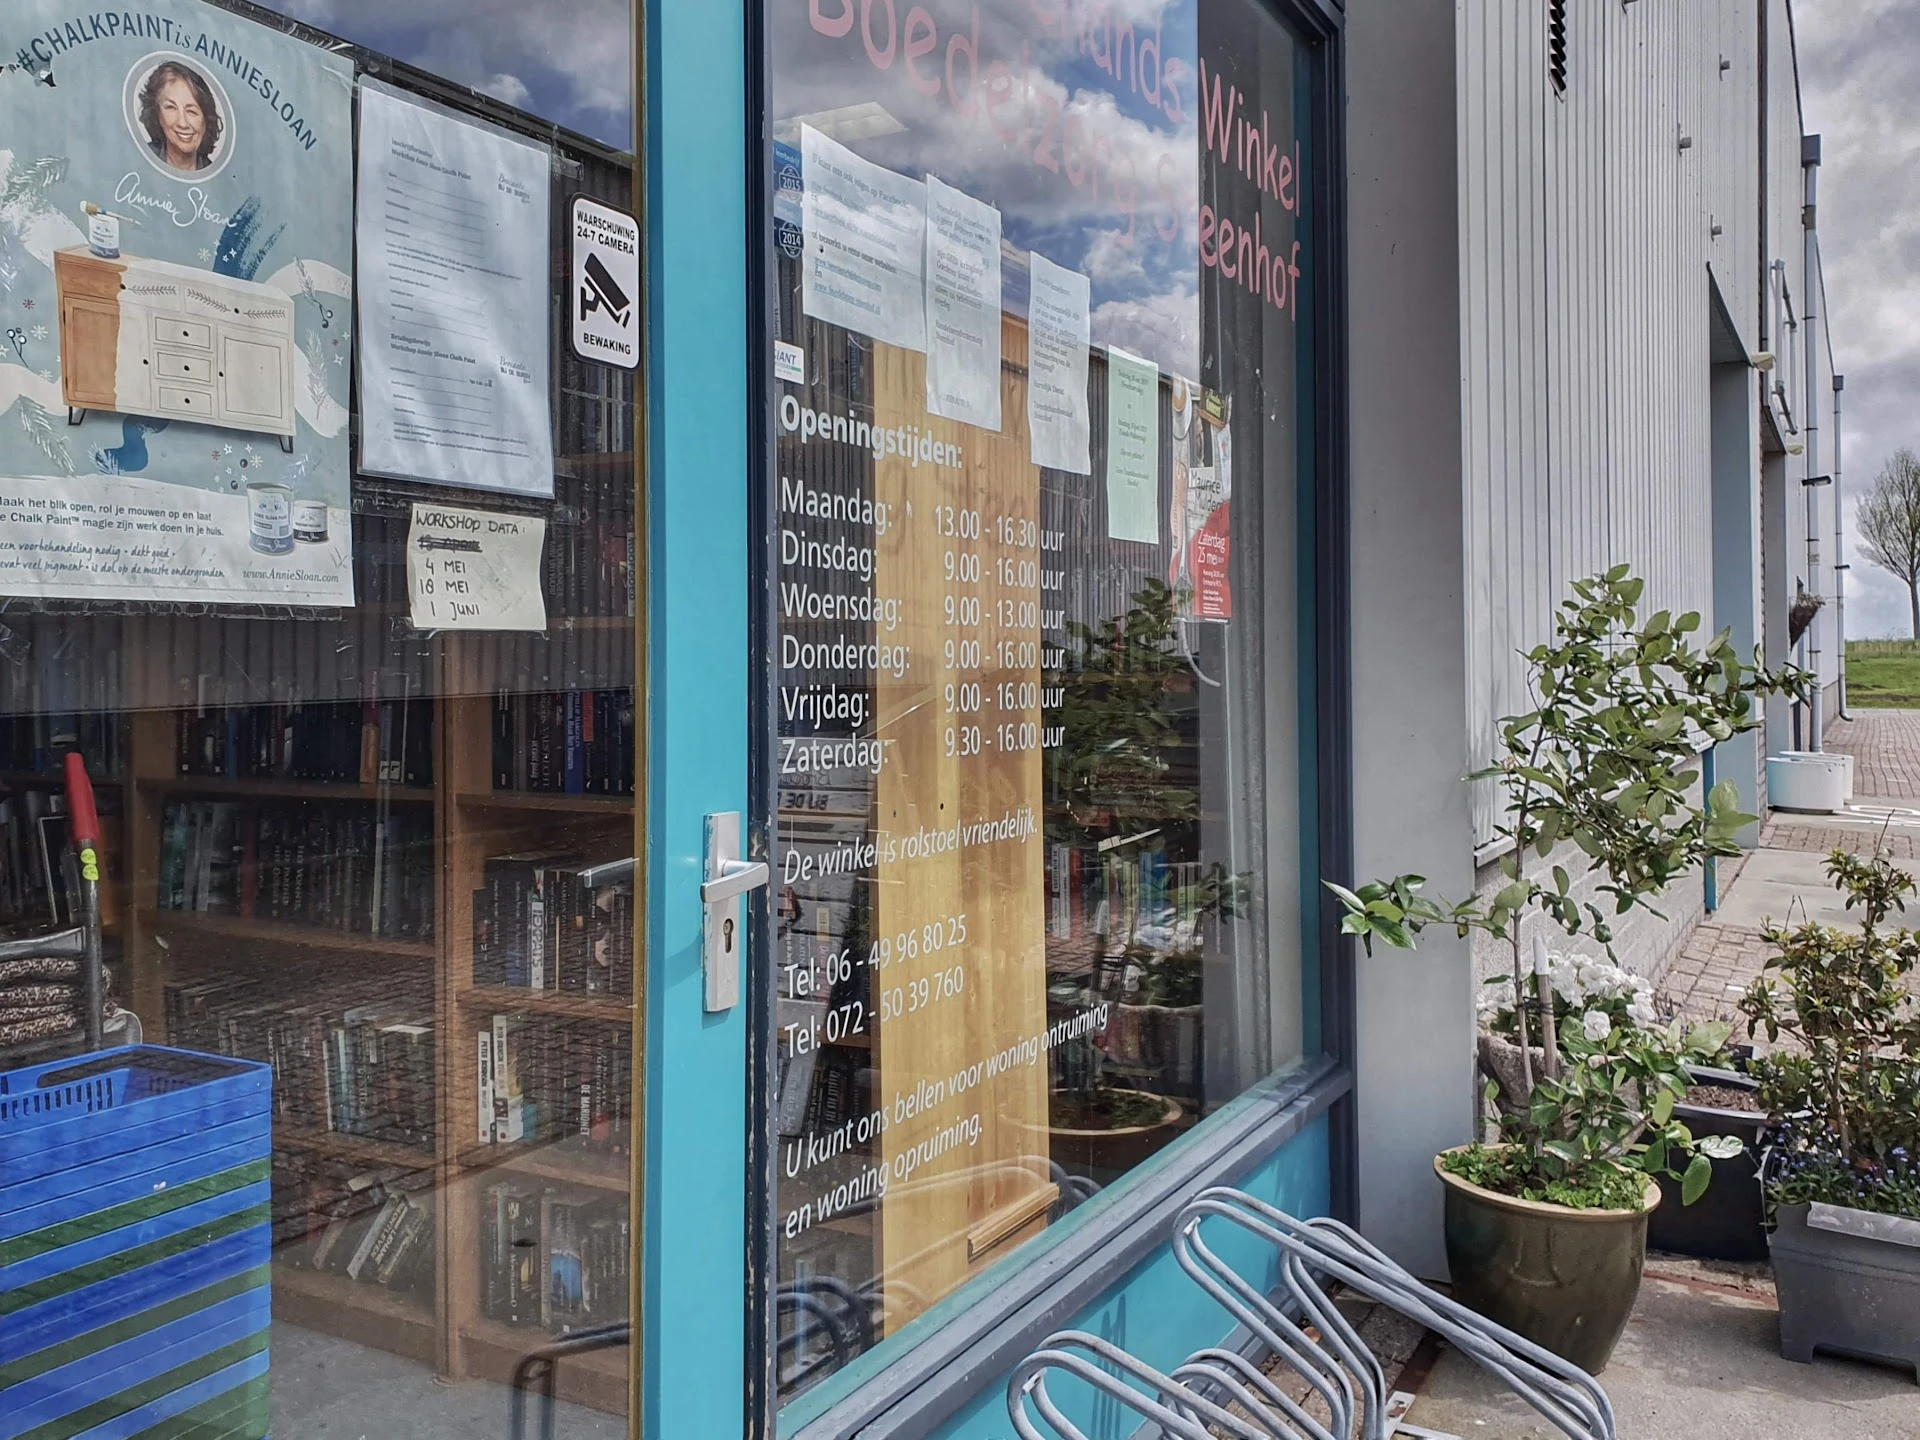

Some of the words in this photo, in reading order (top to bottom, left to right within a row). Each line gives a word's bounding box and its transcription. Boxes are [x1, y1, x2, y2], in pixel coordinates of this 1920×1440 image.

[174, 25, 191, 47] is
[195, 33, 317, 151] ANNIESLOAN
[1200, 57, 1300, 217] Winkel
[782, 176, 800, 190] 2015
[576, 210, 635, 241] WAARSCHUWING
[577, 225, 595, 241] 24-7
[598, 229, 635, 256] CAMERA
[782, 232, 800, 246] 2014
[583, 333, 631, 355] BEWAKING
[780, 394, 963, 468] Openingstijden:
[10, 512, 42, 523] Chalk
[83, 519, 113, 530] magie
[116, 520, 133, 531] zijn
[136, 521, 157, 531] werk
[160, 522, 182, 533] doen
[185, 524, 193, 533] in
[196, 524, 204, 536] je
[206, 525, 224, 536] huis.
[29, 498, 46, 509] het
[50, 499, 67, 510] blik
[70, 503, 96, 514] open,
[99, 504, 112, 514] rol
[115, 504, 125, 516] je
[128, 507, 165, 518] mouwen
[169, 509, 180, 520] op
[183, 510, 194, 520] en
[197, 511, 212, 521] laat
[416, 510, 480, 533] WORKSHOP
[782, 476, 892, 536] Maandag:
[935, 505, 980, 540] 13.00
[996, 516, 1036, 549] 16.30
[1041, 529, 1065, 552] uur
[19, 538, 93, 561] voorbehandeling
[95, 545, 120, 562] nodig
[1198, 528, 1225, 553] Zaterdag
[23, 557, 42, 570] veel
[45, 559, 83, 577] pigment
[100, 561, 117, 574] dol
[118, 564, 128, 578] op
[171, 565, 224, 582] ondergronden
[242, 568, 339, 583] www.AnnieSloan.com
[426, 557, 434, 575] 4
[444, 560, 466, 574] MEI
[782, 530, 878, 582] Dinsdag:
[944, 551, 980, 583] 9.00
[996, 557, 1036, 589] 16.00
[1041, 570, 1065, 591] uur
[420, 578, 434, 595] 18
[445, 580, 469, 593] MEI
[449, 601, 480, 621] JUNI
[781, 582, 903, 631] Woensdag:
[944, 595, 980, 626] 9.00
[996, 599, 1036, 629] 13.00
[1041, 609, 1065, 630] uur
[782, 634, 910, 678] Donderdag:
[944, 640, 980, 669] 9.00
[996, 641, 1036, 669] 16.00
[1041, 650, 1065, 669] uur
[781, 684, 870, 729] Vrijdag:
[945, 683, 981, 713] 9.00
[996, 682, 1037, 710] 16.00
[1041, 688, 1065, 709] uur
[782, 733, 889, 774] Zaterdag:
[945, 726, 981, 757] 9.30
[997, 722, 1037, 752] 16.00
[1041, 725, 1065, 749] uur
[783, 849, 812, 885] De
[818, 833, 879, 878] winkel
[883, 836, 896, 864] is
[900, 819, 960, 861] rolstoel
[963, 806, 1038, 847] vriendelijk.
[784, 958, 821, 1000] Tel:
[826, 949, 851, 986] 06
[868, 937, 890, 971] 49
[896, 928, 918, 963] 96
[923, 921, 943, 955] 80
[948, 914, 966, 947] 25
[784, 1015, 822, 1058] Tel:
[826, 1001, 863, 1042] 072
[881, 988, 903, 1023] 50
[909, 978, 929, 1013] 39
[936, 966, 964, 1001] 760
[581, 1084, 591, 1094] DE
[785, 1138, 803, 1179] U
[807, 1119, 853, 1168] kunt
[857, 1110, 889, 1142] ons
[895, 1079, 944, 1125] bellen
[949, 1063, 984, 1098] voor
[986, 1034, 1038, 1079] woning
[1041, 1003, 1108, 1050] ontruiming
[580, 1096, 591, 1136] MARIONET
[785, 1204, 811, 1238] en
[817, 1161, 889, 1222] woning
[894, 1113, 983, 1183] opruiming.
